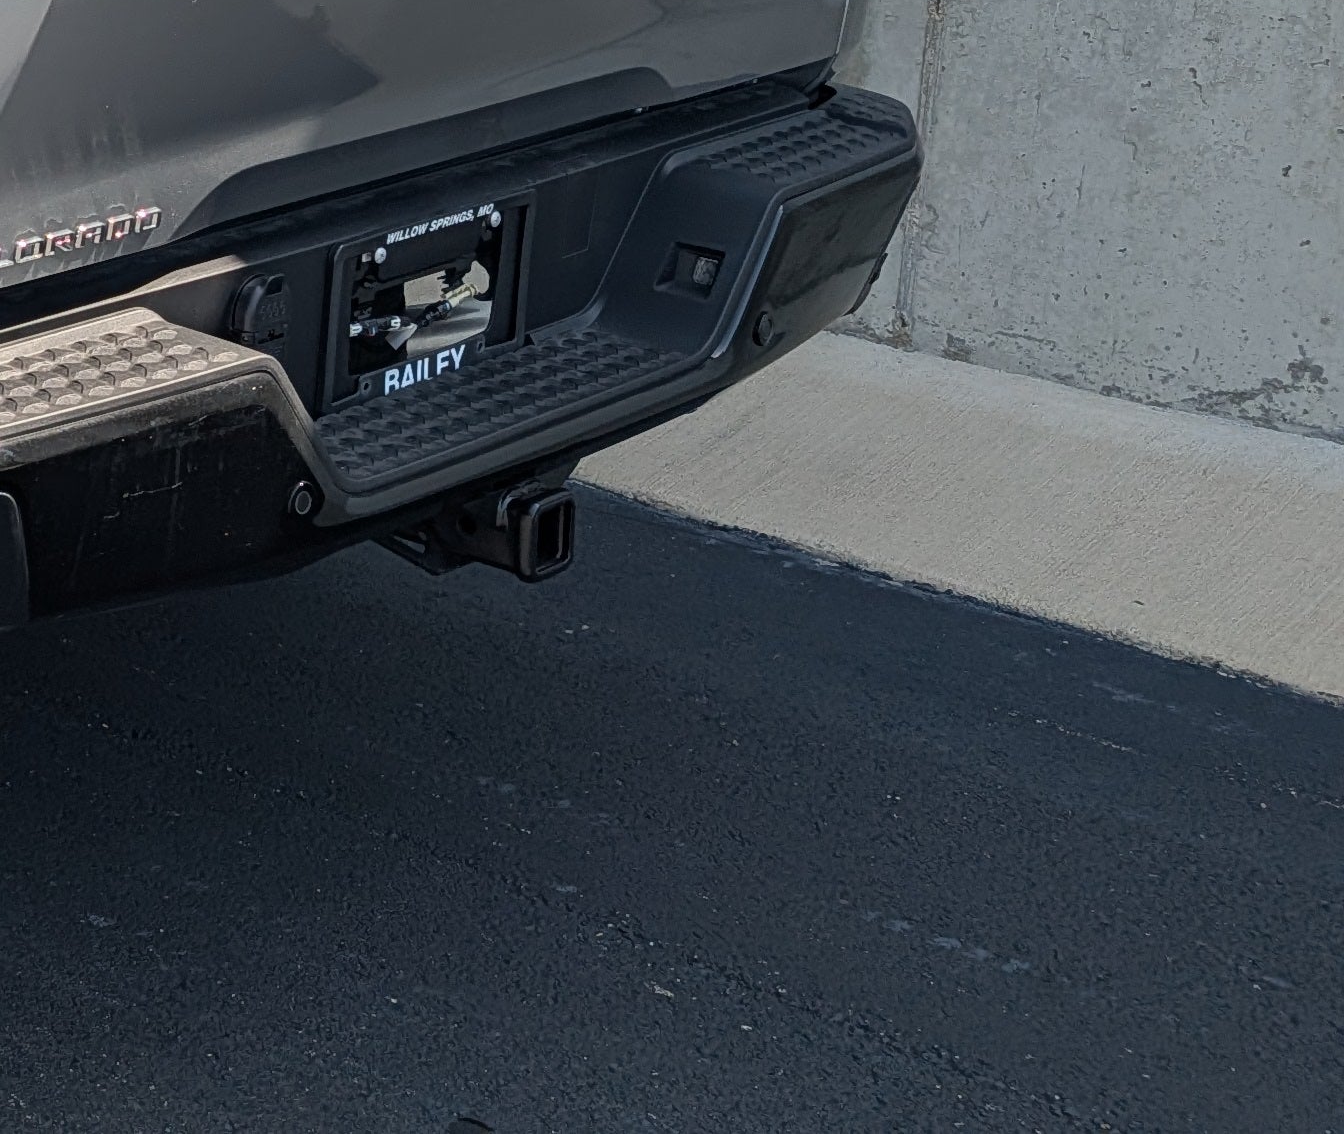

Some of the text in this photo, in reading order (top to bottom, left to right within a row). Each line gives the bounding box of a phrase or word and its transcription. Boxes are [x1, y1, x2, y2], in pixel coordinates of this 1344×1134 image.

[386, 203, 494, 245] WILLOW SPRINGS, MO
